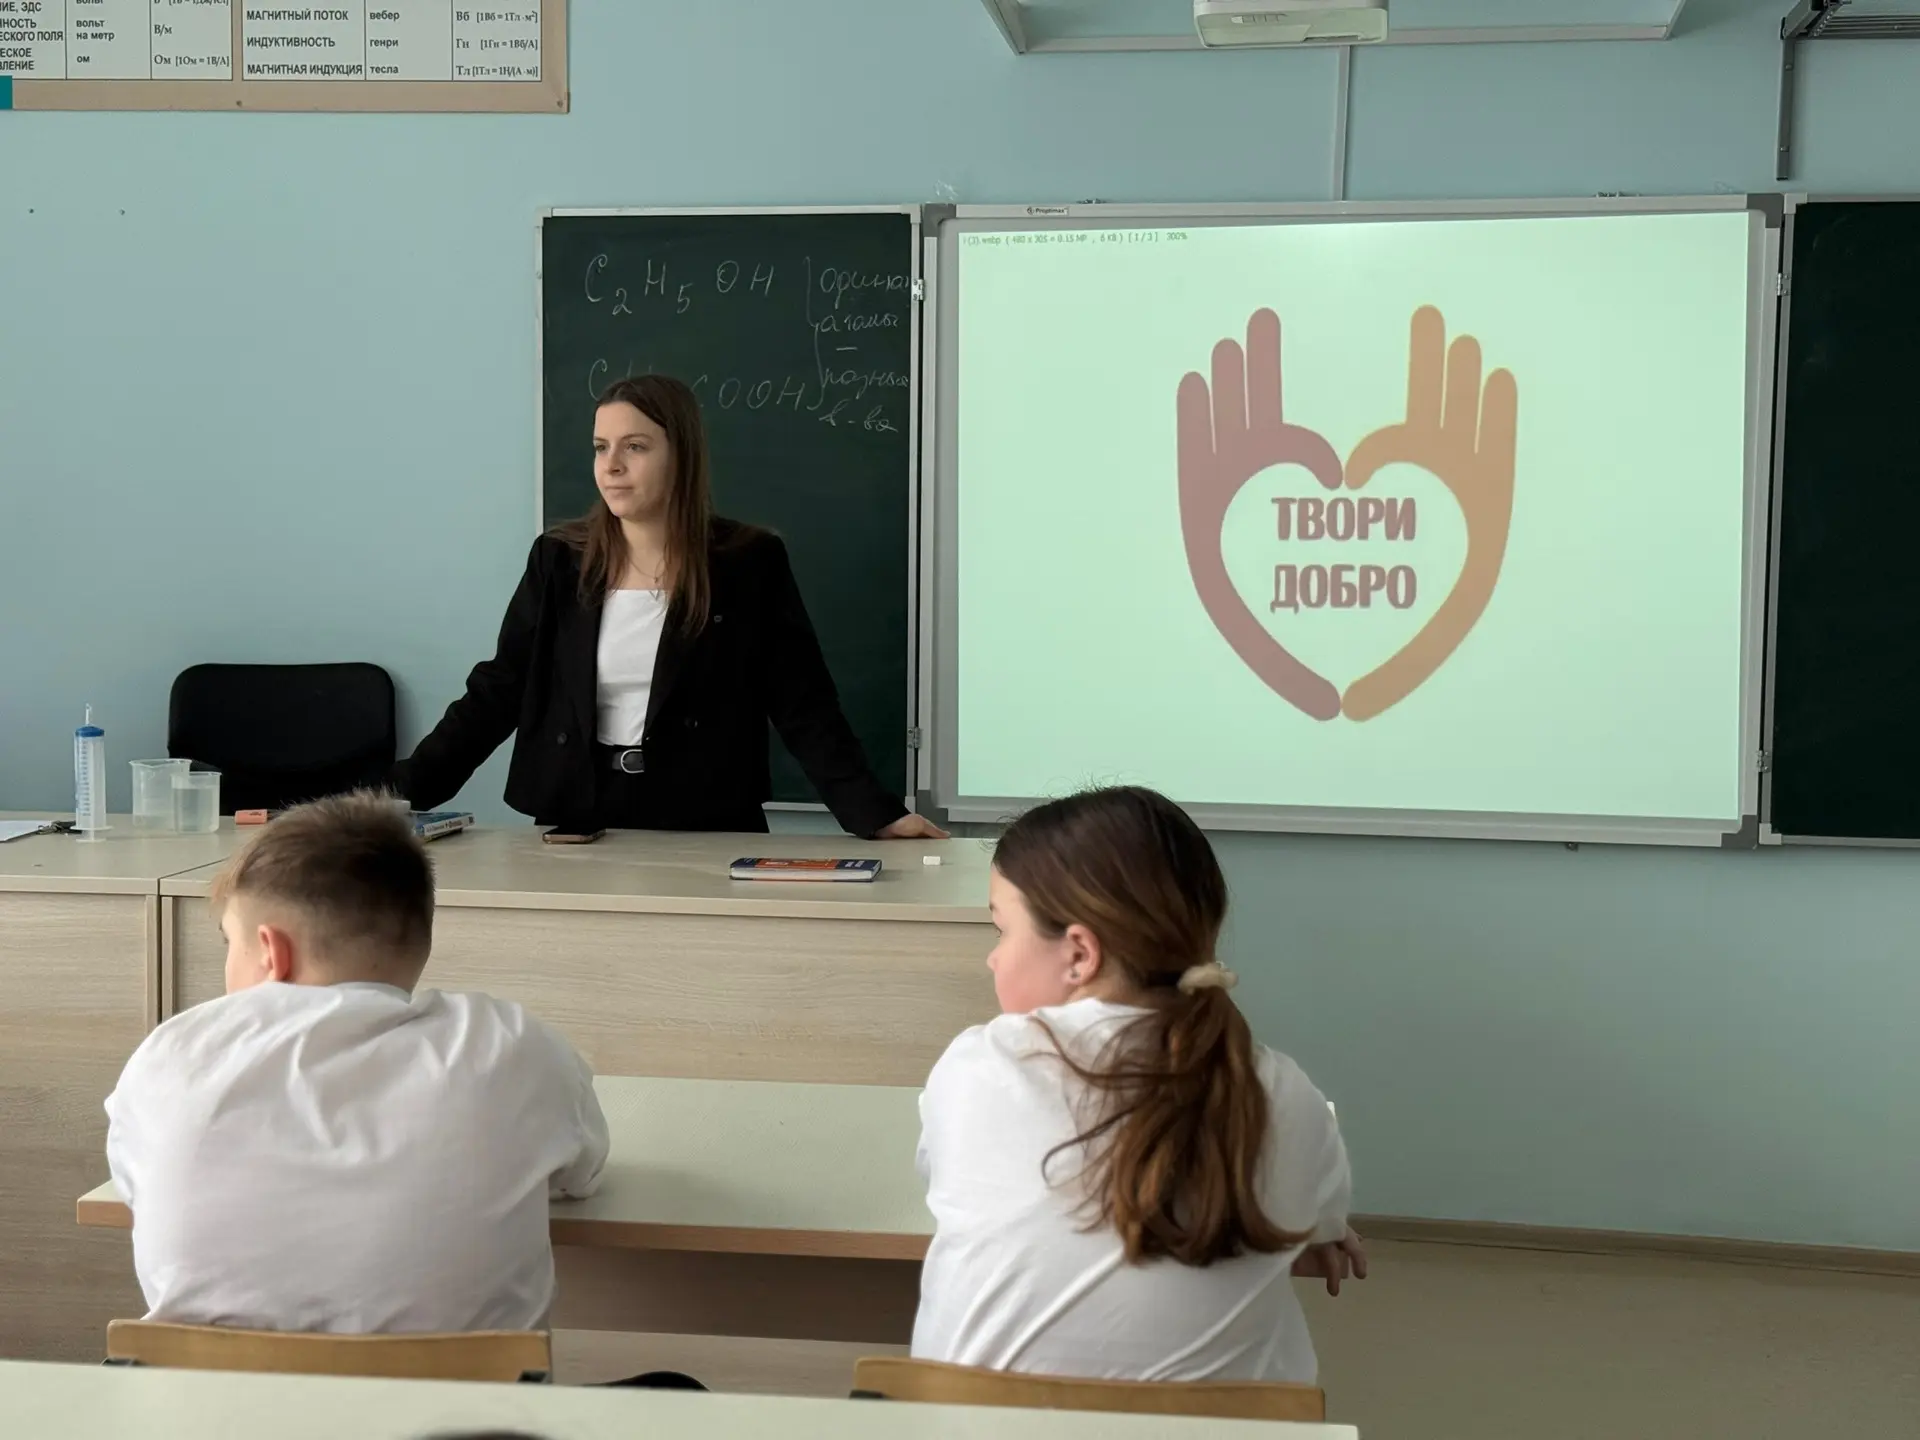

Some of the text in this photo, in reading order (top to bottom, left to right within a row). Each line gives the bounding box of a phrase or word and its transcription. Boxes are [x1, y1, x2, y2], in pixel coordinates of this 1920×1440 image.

[0, 2, 42, 13] ИЕ, ЭДС
[247, 9, 349, 20] МАГНИТНЫЙ ПОТОК
[370, 10, 399, 21] вебер
[456, 11, 470, 21] Вб
[76, 20, 105, 28] вольт
[154, 24, 173, 36] В/м
[37, 31, 64, 41] ПОЛЯ
[91, 32, 115, 41] метр
[247, 37, 336, 48] ИНДУКТИВНОСТЬ
[370, 39, 399, 48] генри
[456, 38, 470, 48] Гн
[76, 55, 90, 63] ом
[154, 54, 171, 65] Ом
[247, 64, 363, 76] МАГНИТНАЯ ИНДУКЦИЯ
[370, 66, 399, 74] тесла
[456, 65, 471, 76] Тл
[1271, 497, 1417, 541] ТВОРИ
[1270, 564, 1418, 615] ДОБРО
